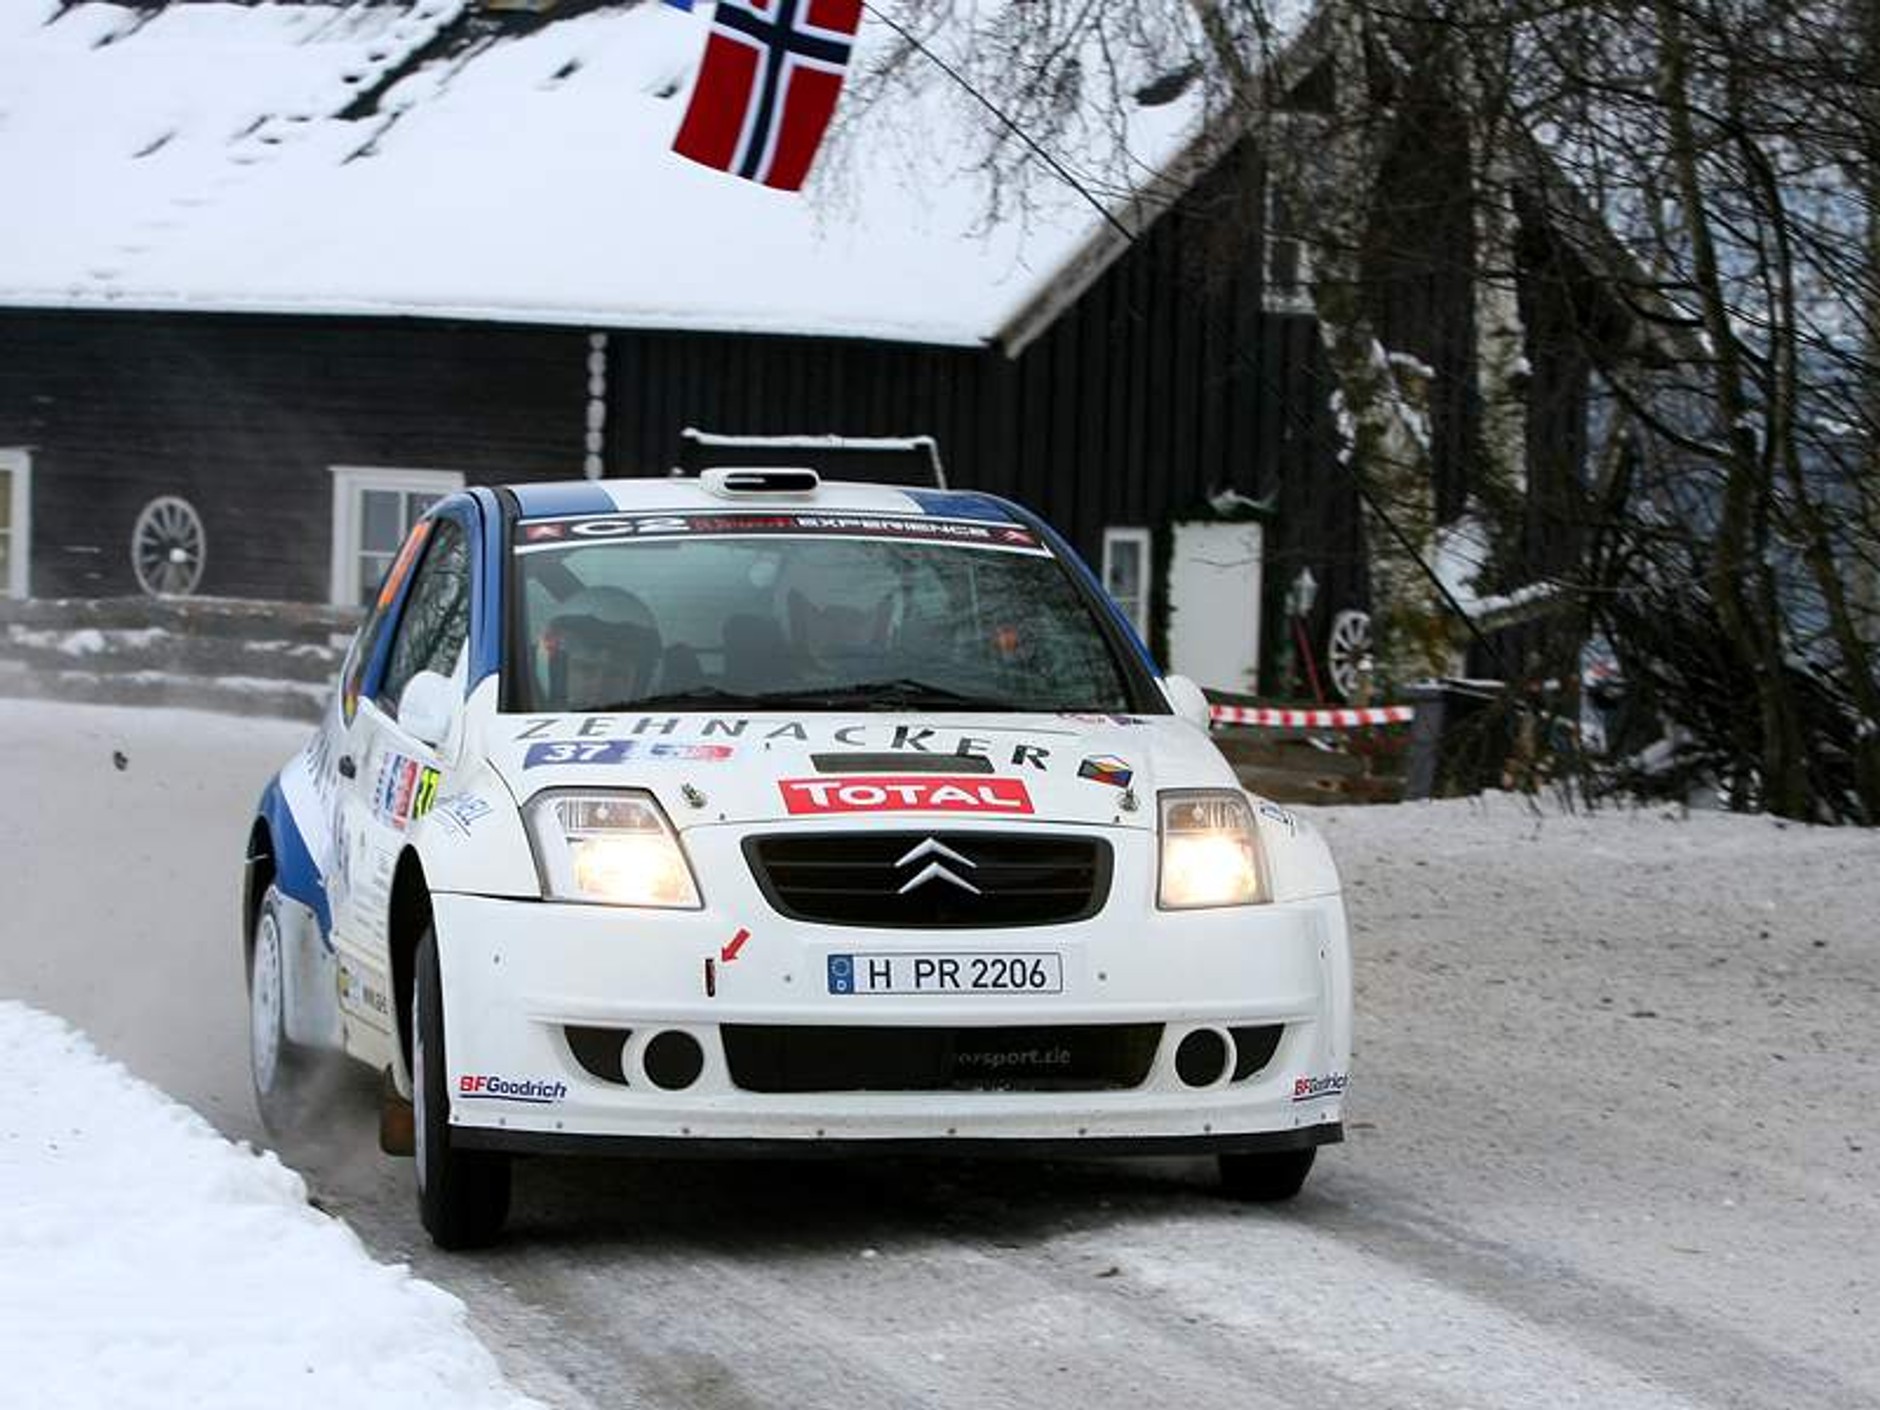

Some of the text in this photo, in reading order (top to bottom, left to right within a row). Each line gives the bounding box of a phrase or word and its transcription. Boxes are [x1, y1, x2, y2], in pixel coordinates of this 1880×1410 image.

[570, 517, 691, 536] C2
[515, 716, 1050, 771] ZEHNACKER
[541, 743, 612, 761] 37
[790, 780, 1022, 807] TOTAL
[868, 958, 1047, 989] H PR 2206
[459, 1075, 568, 1099] BFGoodrich
